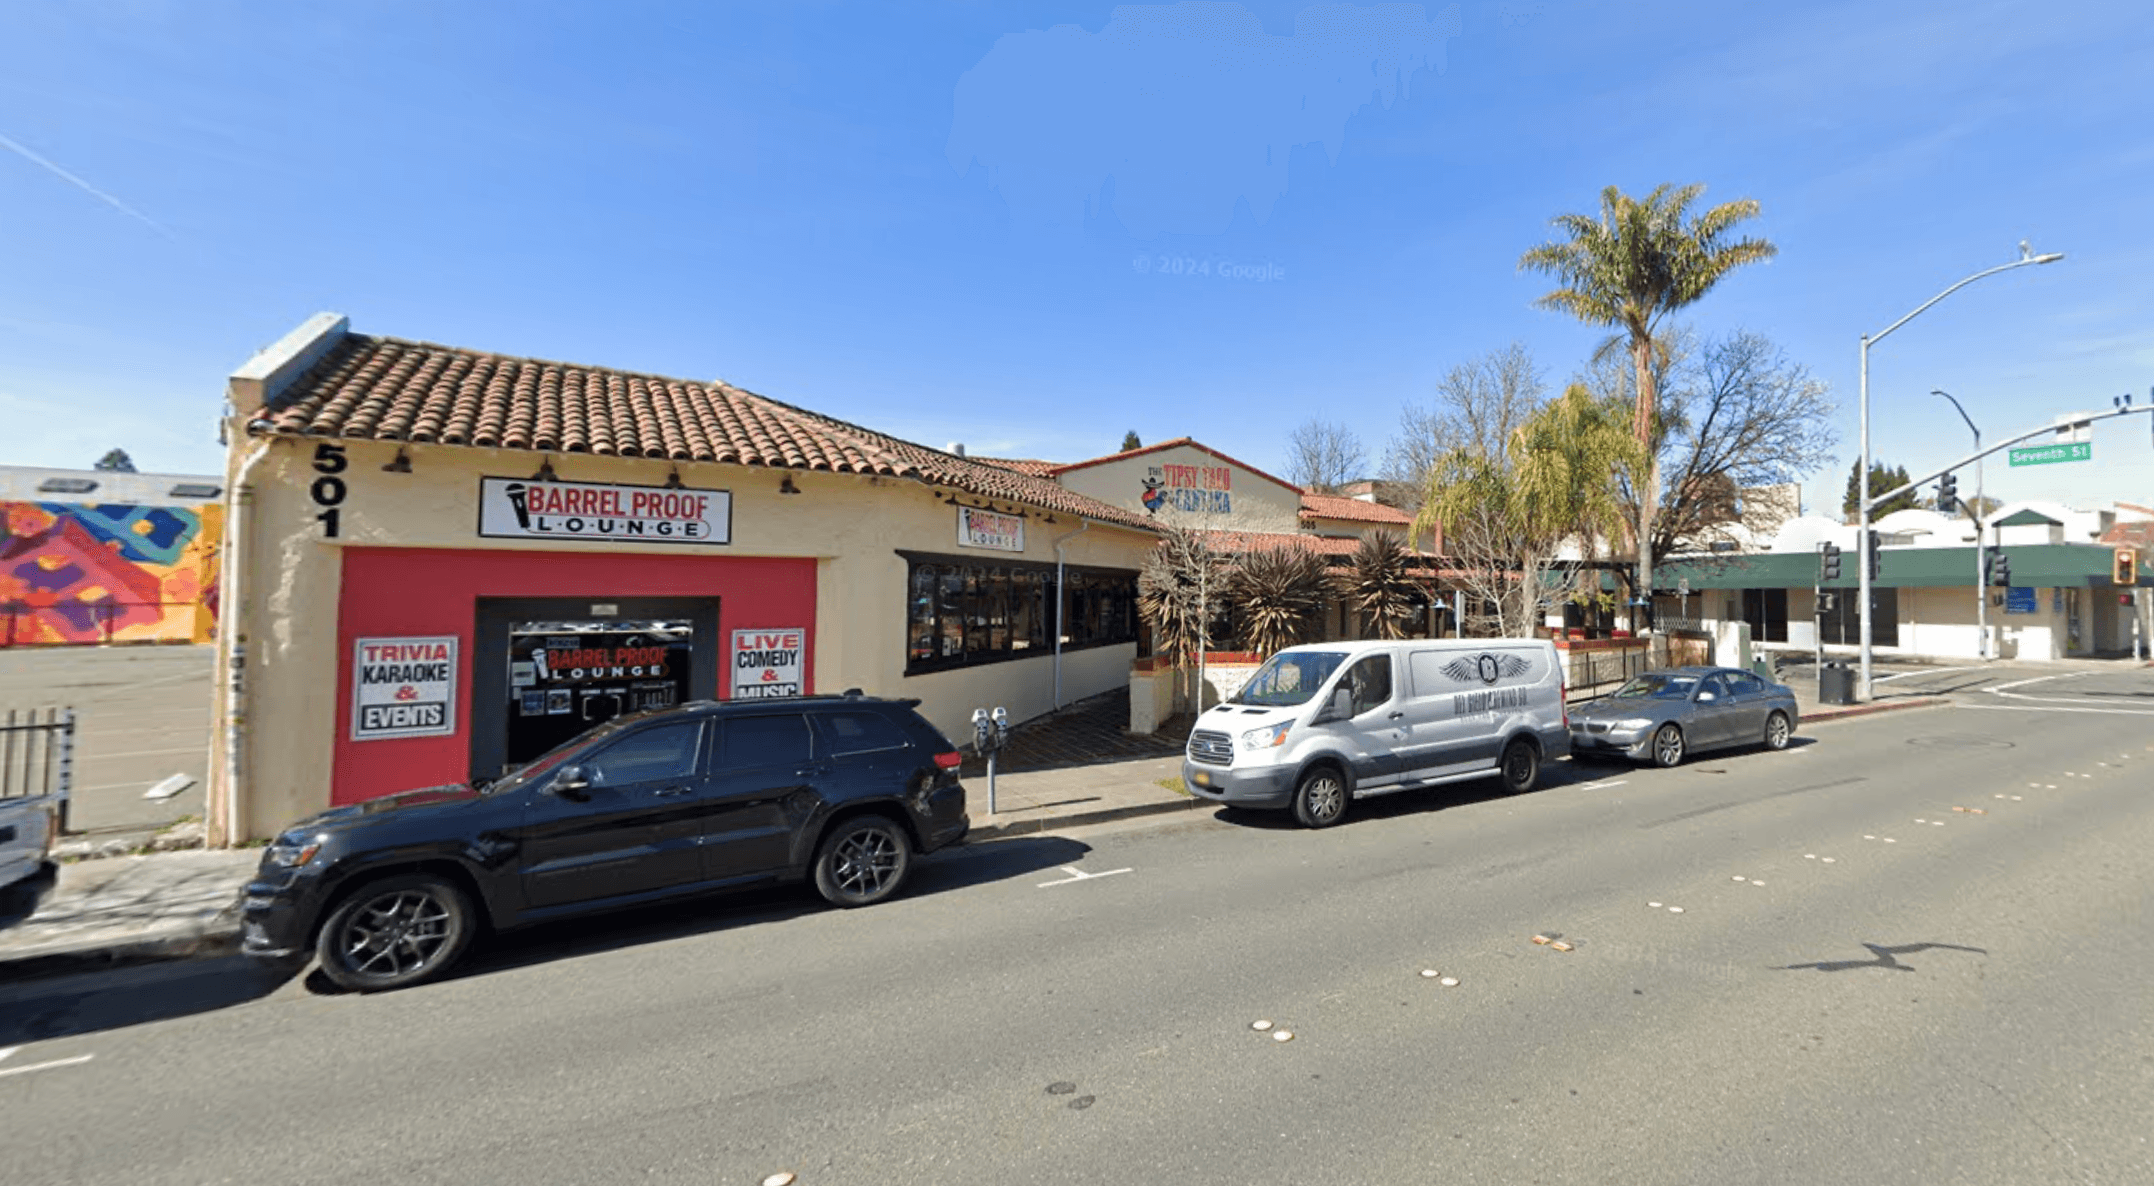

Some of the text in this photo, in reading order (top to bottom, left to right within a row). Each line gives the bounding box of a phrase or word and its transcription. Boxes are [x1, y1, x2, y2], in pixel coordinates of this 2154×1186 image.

[2012, 449, 2067, 463] Seventh
[1163, 464, 1198, 488] TIPSY
[311, 443, 348, 537] 501
[528, 485, 709, 521] BARREL PROOF
[736, 634, 799, 650] LIVE
[364, 644, 448, 662] TRIVIA
[547, 647, 668, 670] BARREL PROOF
[737, 649, 798, 668] COMEDY
[363, 663, 448, 684] KARAOKE
[761, 668, 778, 682] &
[394, 684, 419, 701] &
[365, 704, 442, 729] EVENTS
